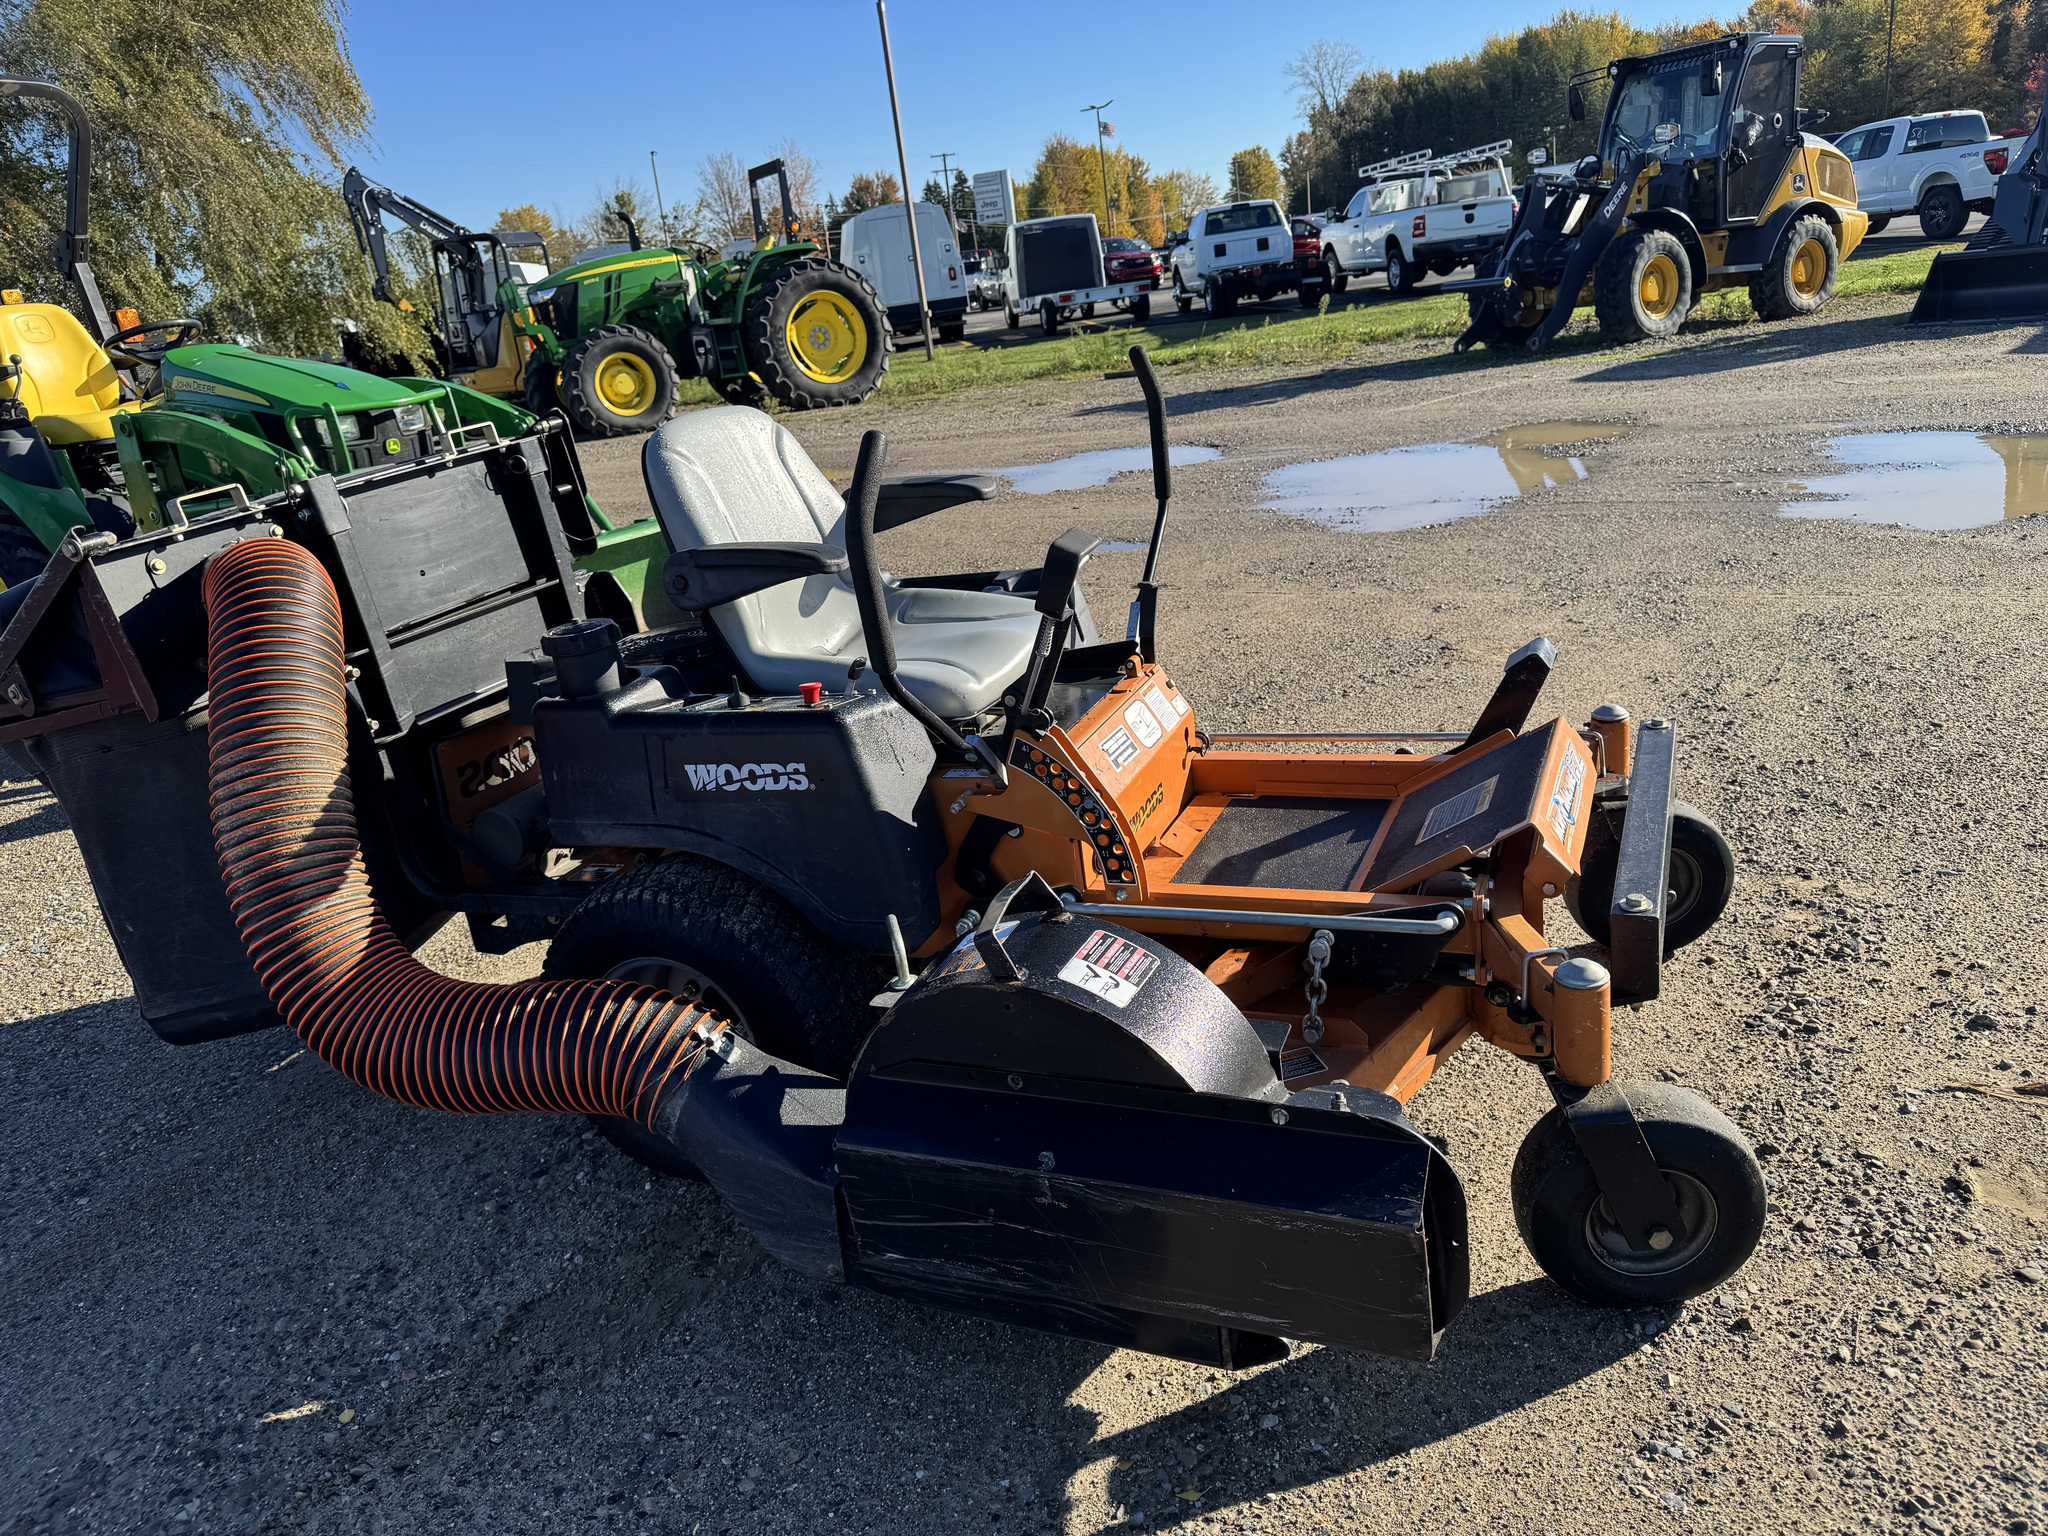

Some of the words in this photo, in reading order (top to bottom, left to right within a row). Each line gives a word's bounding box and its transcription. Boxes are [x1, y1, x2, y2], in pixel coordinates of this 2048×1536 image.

[980, 200, 998, 209] Jeep
[1603, 181, 1628, 219] DEERE
[174, 379, 192, 391] JOHN
[192, 380, 217, 394] DEERE
[684, 762, 809, 791] WOODS
